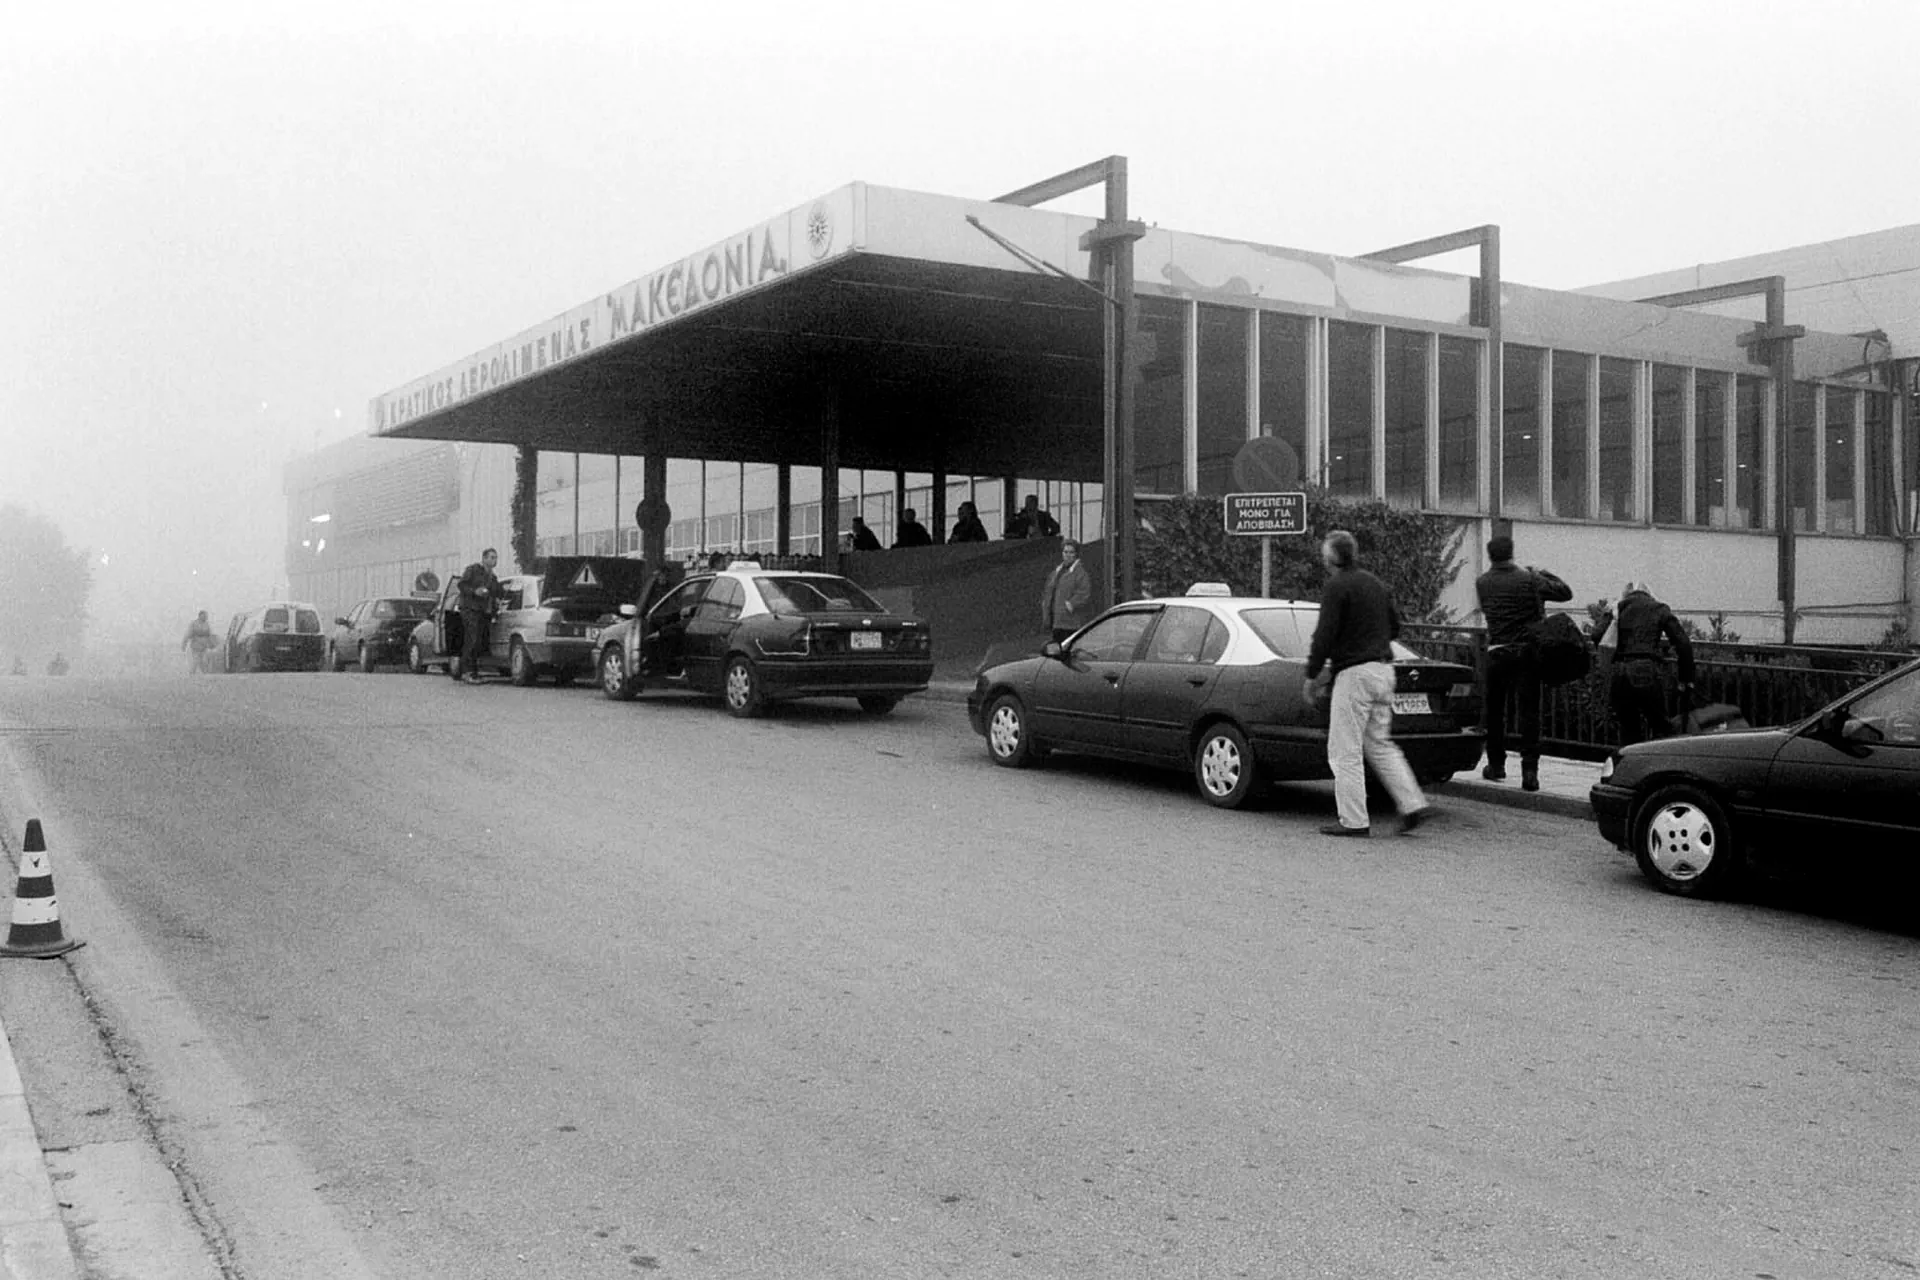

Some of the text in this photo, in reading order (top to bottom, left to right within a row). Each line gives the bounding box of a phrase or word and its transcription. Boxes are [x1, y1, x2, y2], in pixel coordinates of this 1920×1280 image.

[1234, 497, 1297, 508] ΕΠΙΤΡΕΠΕΤΑΙ
[1239, 508, 1292, 518] ΜΟΝΟ ΓΙΑ
[1236, 519, 1295, 530] ΑΠΟΒΙΒΑΣΗ
